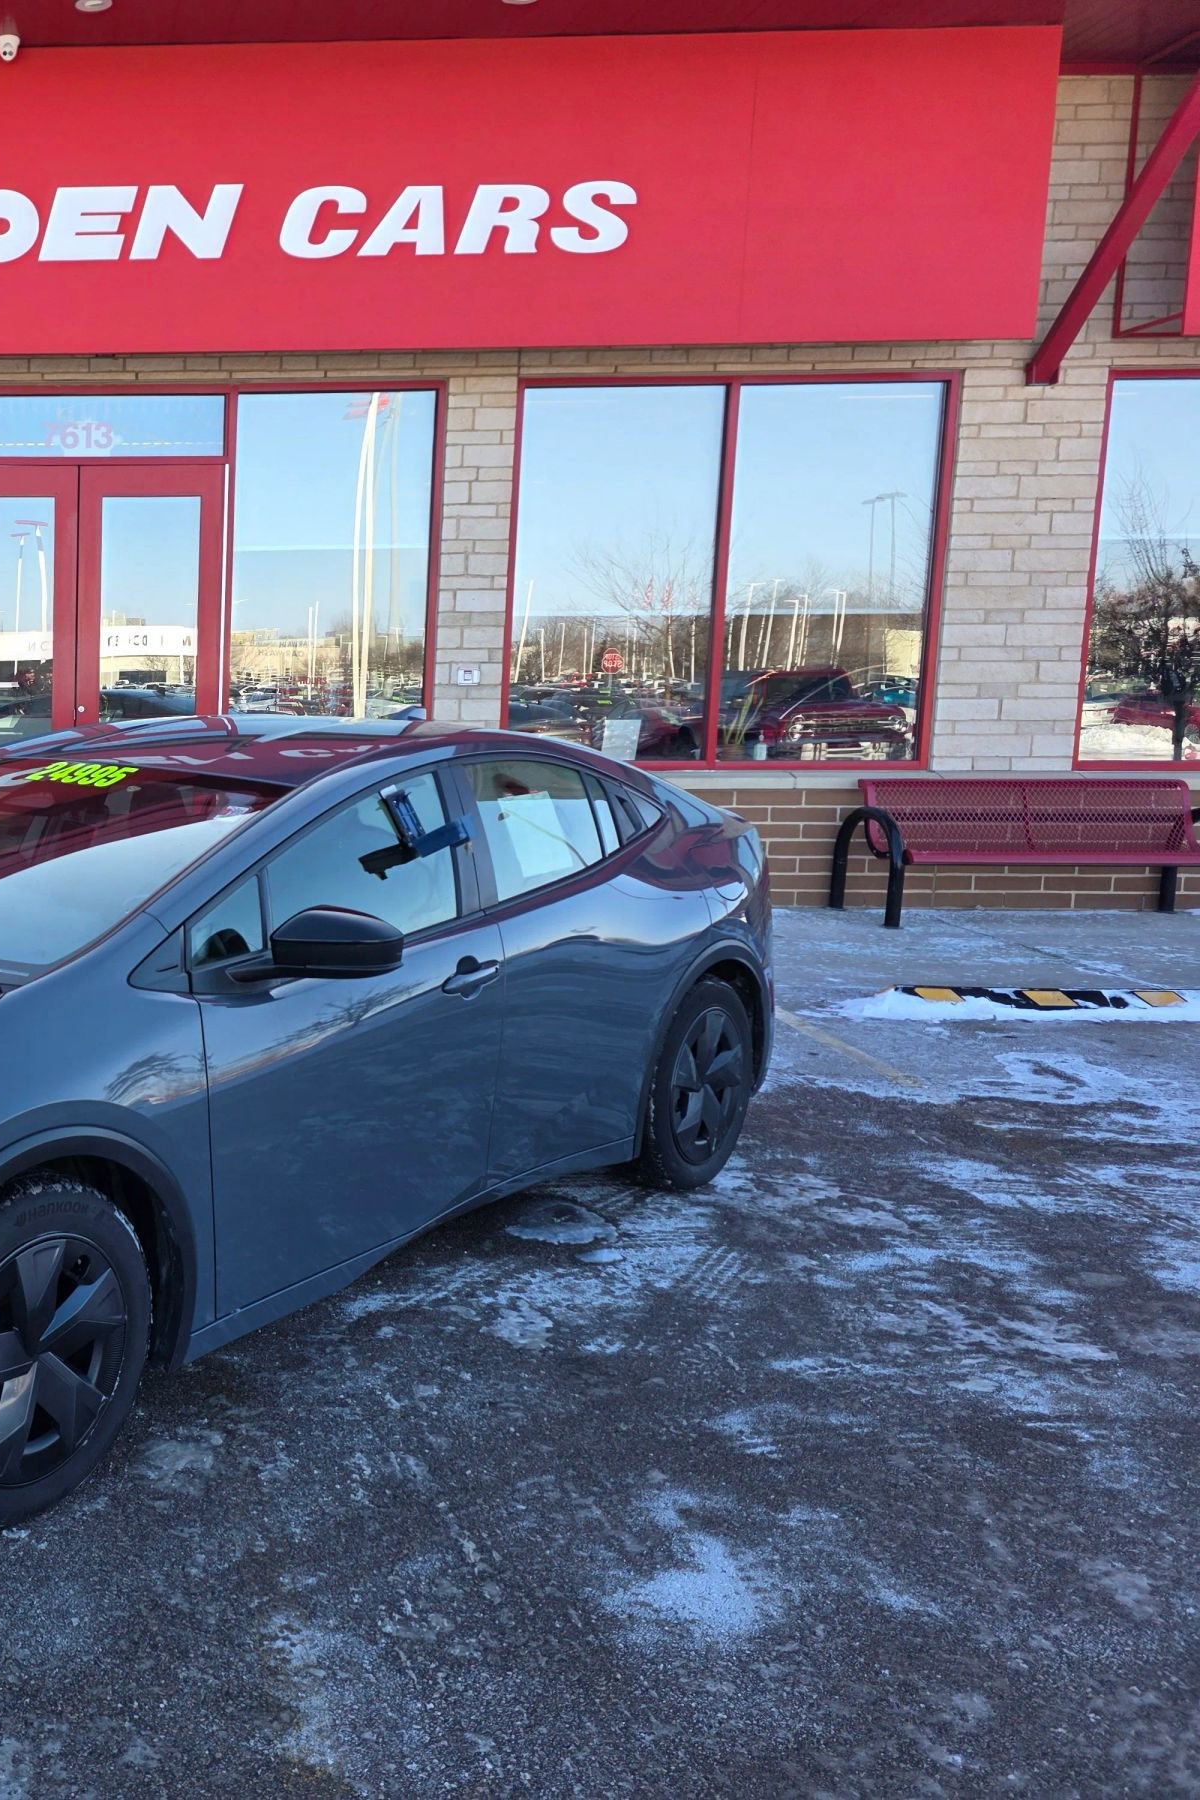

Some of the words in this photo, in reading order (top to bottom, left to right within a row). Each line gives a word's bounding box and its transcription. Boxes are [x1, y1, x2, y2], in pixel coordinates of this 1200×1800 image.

[277, 180, 638, 259] CARS
[43, 421, 113, 450] 7613
[25, 761, 140, 788] 24995
